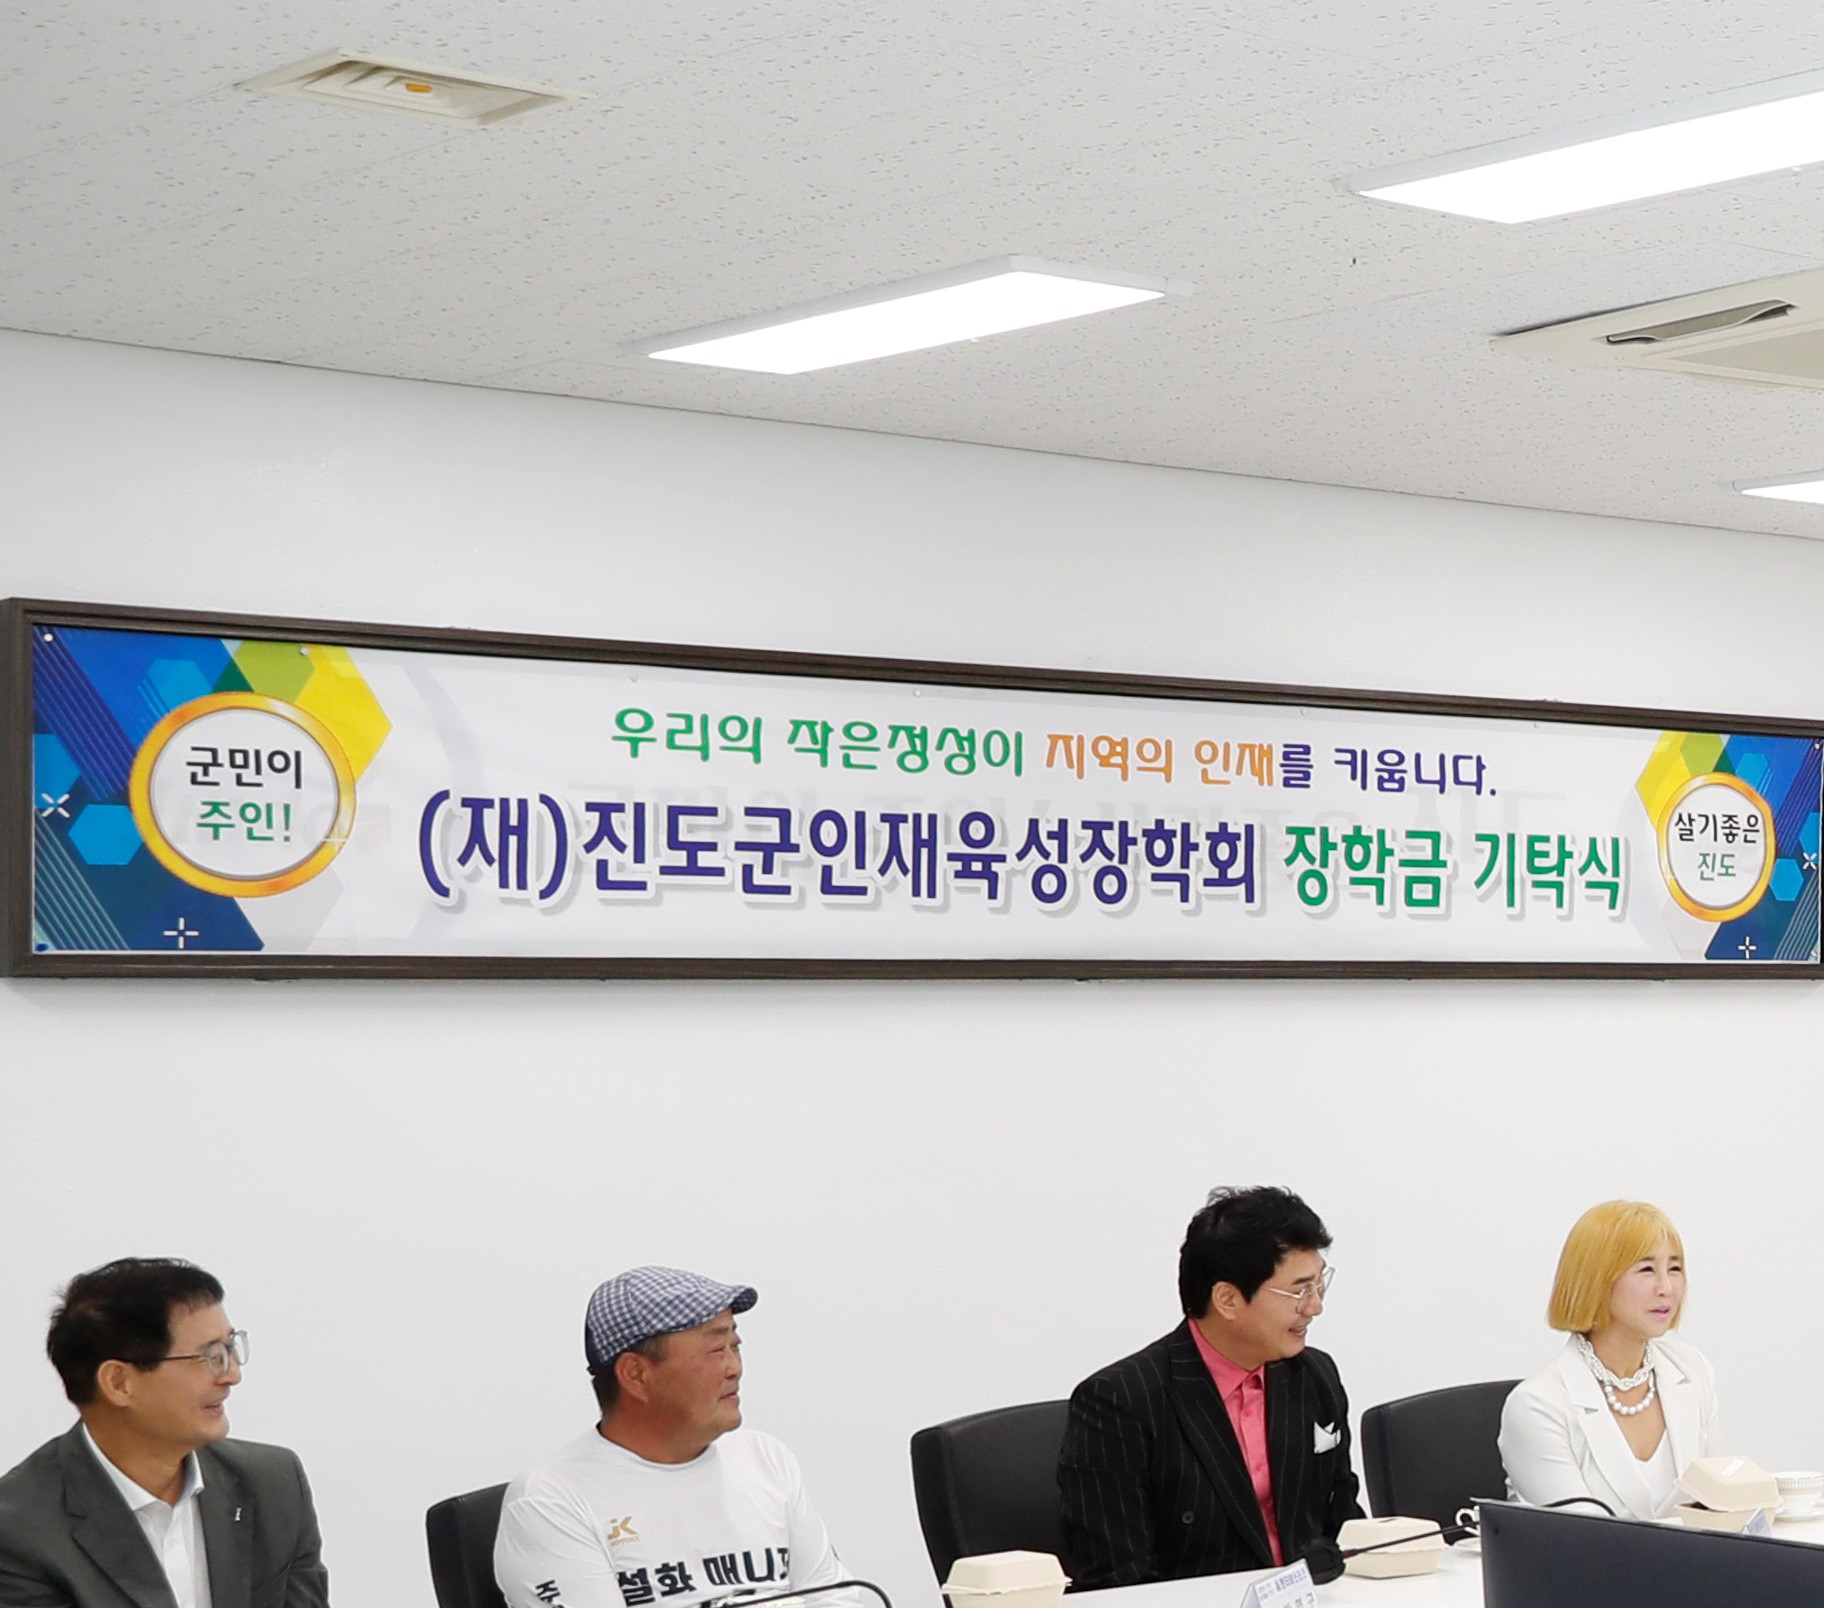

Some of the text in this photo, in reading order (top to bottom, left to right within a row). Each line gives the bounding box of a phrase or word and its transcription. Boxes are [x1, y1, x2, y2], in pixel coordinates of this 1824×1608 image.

[185, 746, 302, 790] 군민이
[612, 708, 1498, 796] 우리의 작은정성이 지역의 인재를 키웁니다.
[196, 800, 292, 843] 주인!
[1672, 811, 1761, 848] 살기좋은
[419, 788, 1622, 911] (재)진도군인재육성장학회 장학금 기탁식
[1697, 852, 1737, 881] 진도
[616, 1561, 697, 1607] 설화
